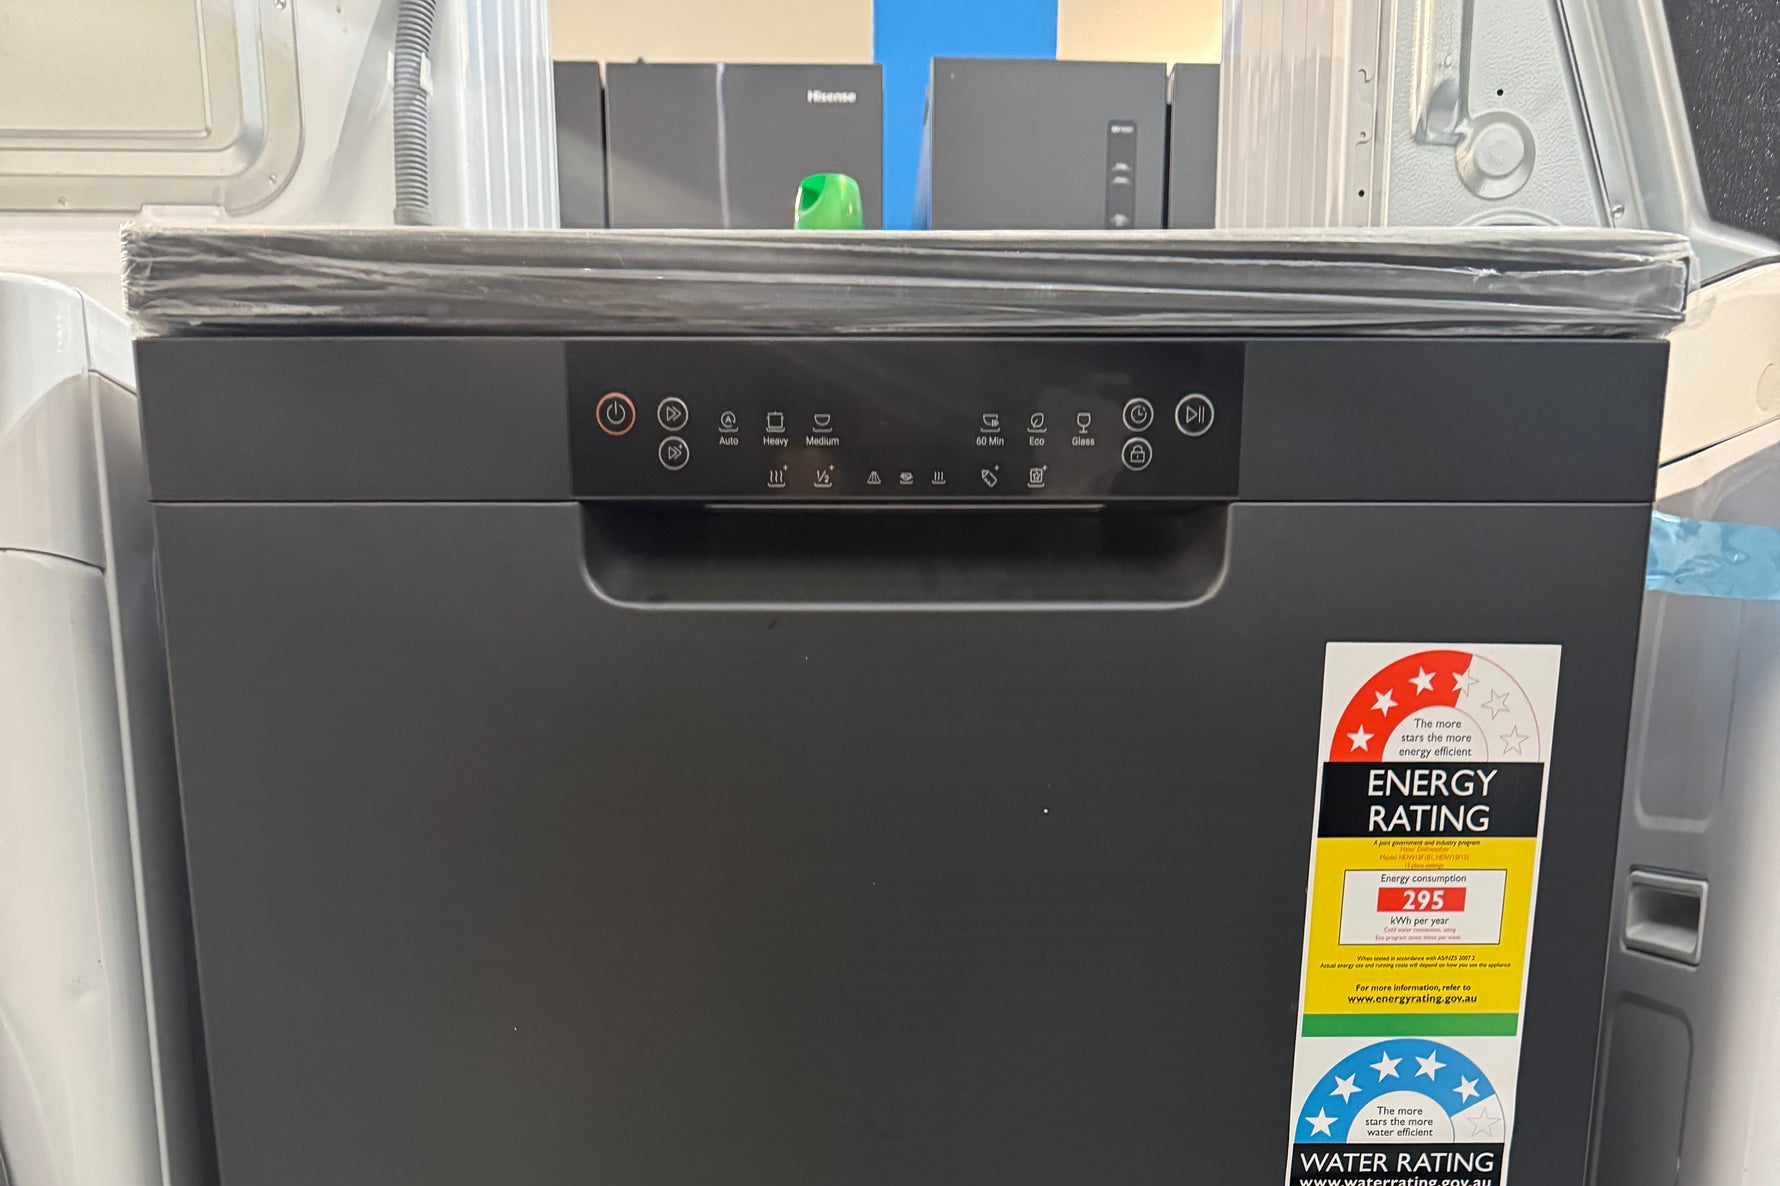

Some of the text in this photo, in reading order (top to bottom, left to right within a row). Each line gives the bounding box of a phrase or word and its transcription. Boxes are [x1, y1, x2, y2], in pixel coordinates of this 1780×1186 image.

[807, 89, 857, 103] Hisense
[719, 436, 739, 446] Auto
[763, 436, 789, 448] Heavy
[805, 436, 840, 446] Medium
[976, 436, 1005, 447] 60 Min
[1029, 436, 1045, 446] Eco
[1072, 436, 1095, 446] Glass
[1414, 718, 1462, 729] The more
[1401, 733, 1472, 743] stars the more
[1399, 746, 1472, 759] energy efficient
[1368, 769, 1497, 797] ENERGY
[1368, 805, 1490, 832] RATING
[1380, 874, 1467, 884] Energy consumption
[1402, 890, 1444, 910] 295
[1390, 916, 1449, 927] kWh per year
[1355, 984, 1369, 992] For
[1393, 984, 1441, 993] information,
[1442, 984, 1461, 992] refer
[1347, 994, 1477, 1005] www.energyrating.gov.au
[1377, 1106, 1423, 1115] The more
[1365, 1117, 1433, 1126] stars the more
[1367, 1127, 1433, 1137] water efficient
[1300, 1152, 1494, 1173] WATER RATING
